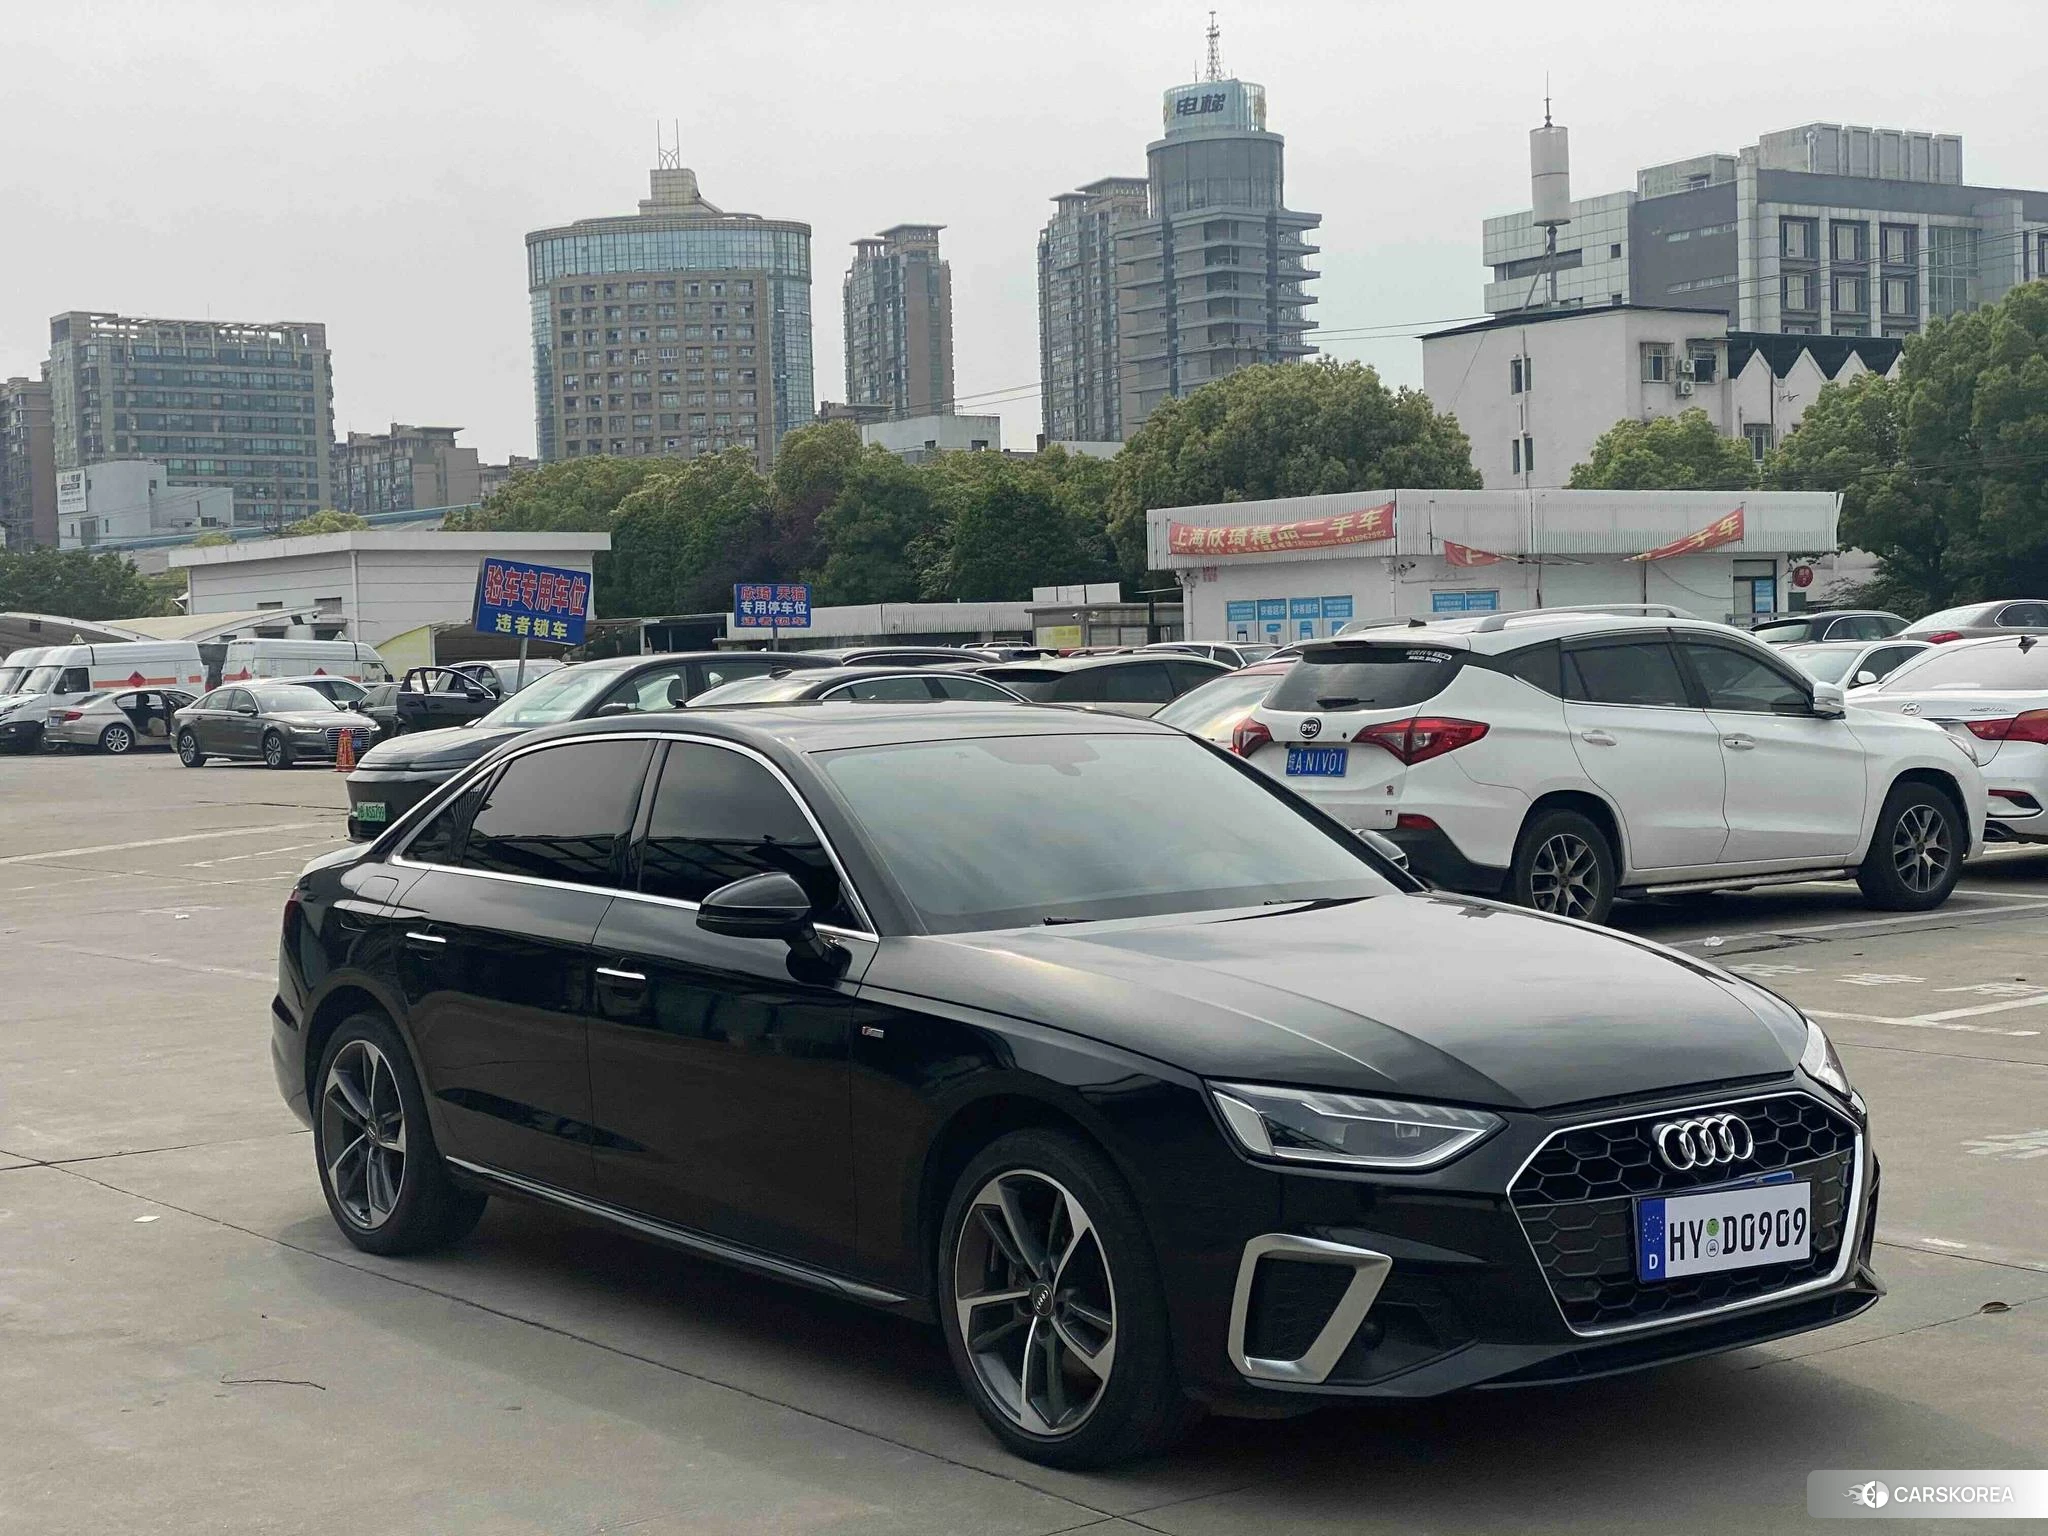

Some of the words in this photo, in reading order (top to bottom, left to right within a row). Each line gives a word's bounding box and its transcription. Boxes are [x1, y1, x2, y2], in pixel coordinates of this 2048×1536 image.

[1176, 93, 1227, 116] 电梯
[485, 564, 587, 617] 验车专用车位
[776, 585, 807, 602] 天猫
[740, 600, 807, 615] 专用停车位
[495, 613, 569, 640] 违者锁车
[1301, 723, 1318, 732] BYD
[1669, 1219, 1704, 1262] HY
[1722, 1207, 1807, 1255] D0909
[1649, 1253, 1659, 1270] D
